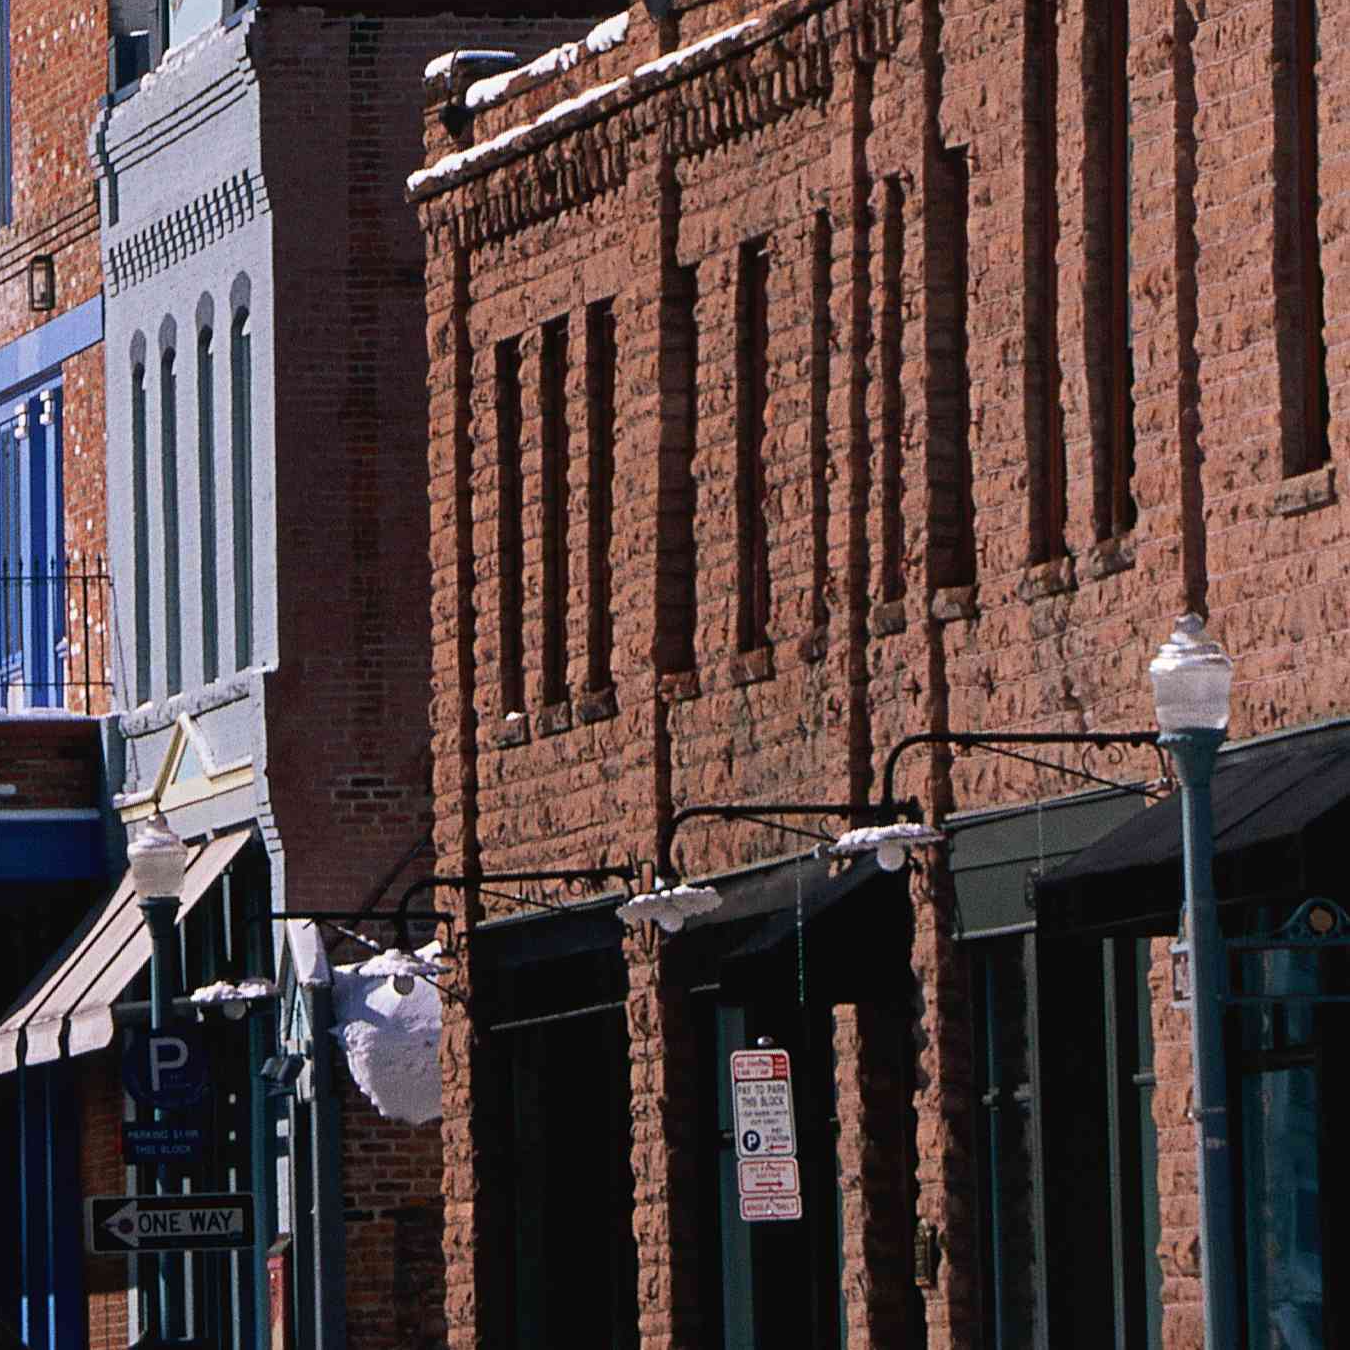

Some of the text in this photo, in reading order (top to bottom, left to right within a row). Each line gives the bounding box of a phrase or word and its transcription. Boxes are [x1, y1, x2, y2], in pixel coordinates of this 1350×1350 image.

[149, 1037, 189, 1091] P
[755, 1084, 766, 1094] TO
[760, 1096, 785, 1107] BLOCK
[747, 1135, 758, 1149] P
[138, 1211, 234, 1234] ONE WAY
